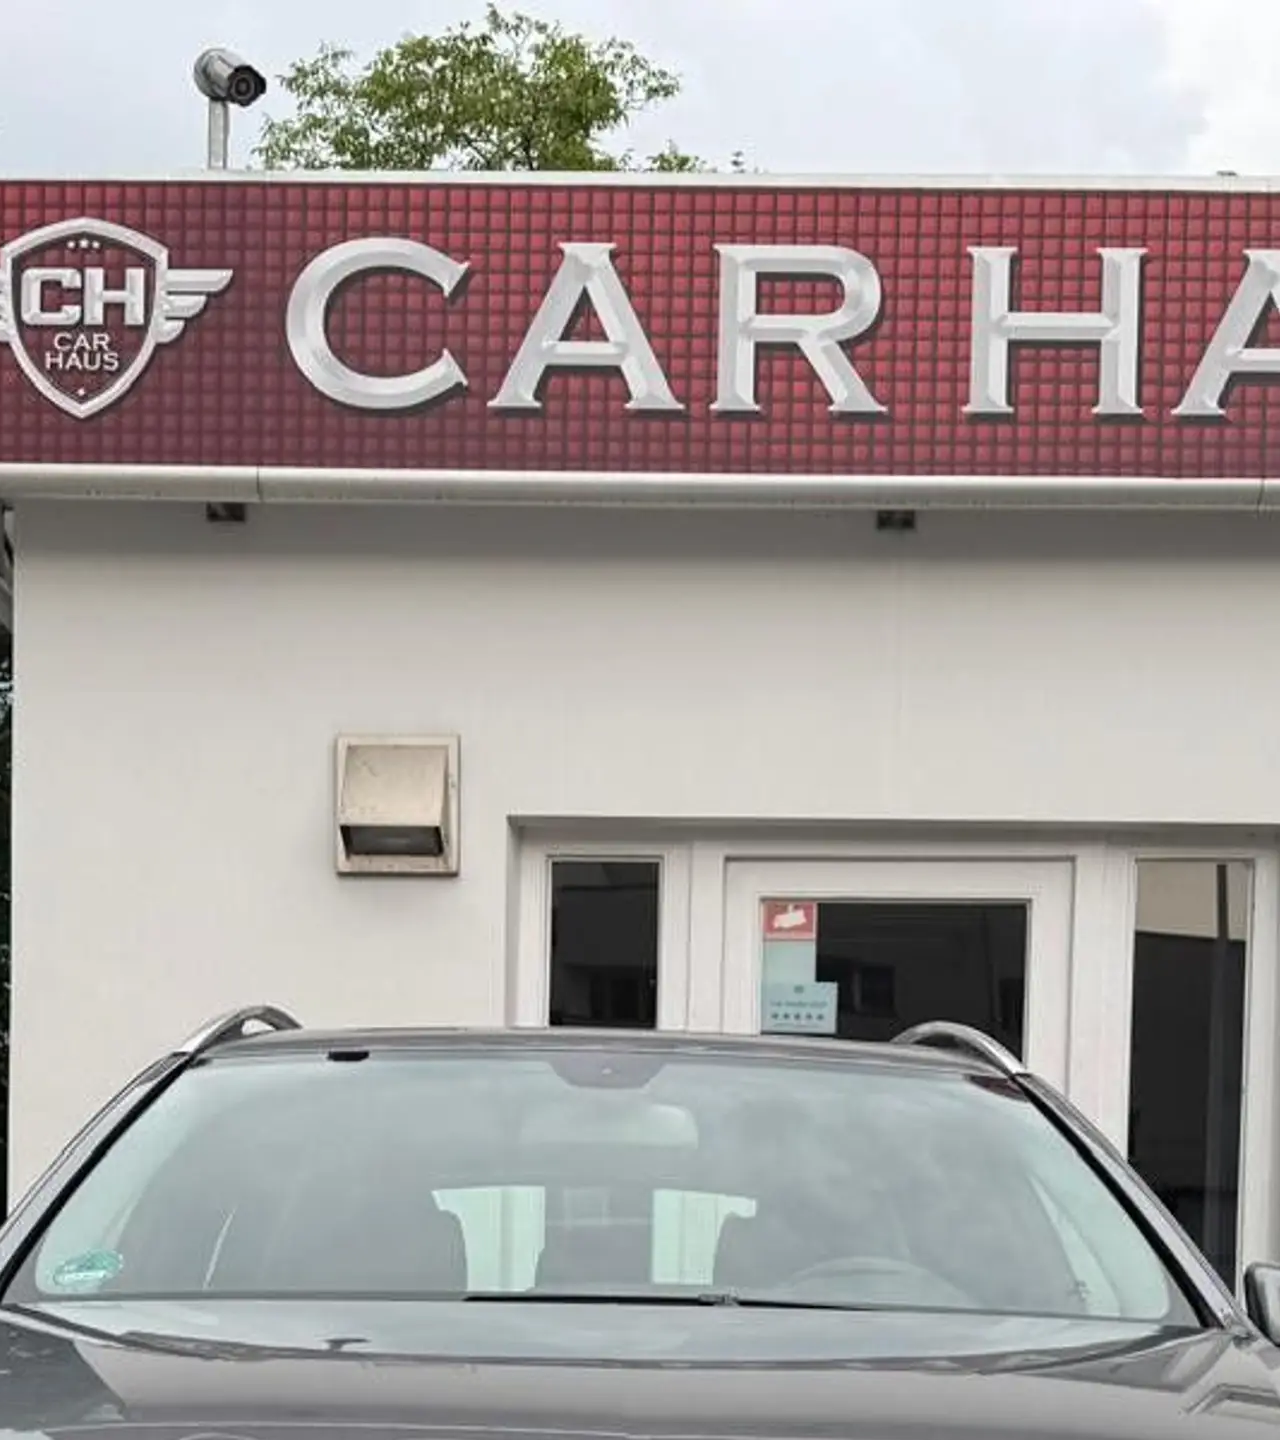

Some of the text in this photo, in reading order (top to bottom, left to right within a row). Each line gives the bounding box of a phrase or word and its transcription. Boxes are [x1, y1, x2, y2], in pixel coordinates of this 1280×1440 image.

[21, 267, 145, 325] CH
[54, 333, 111, 350] CAR
[286, 237, 887, 412] CAR
[45, 352, 119, 371] HAUS
